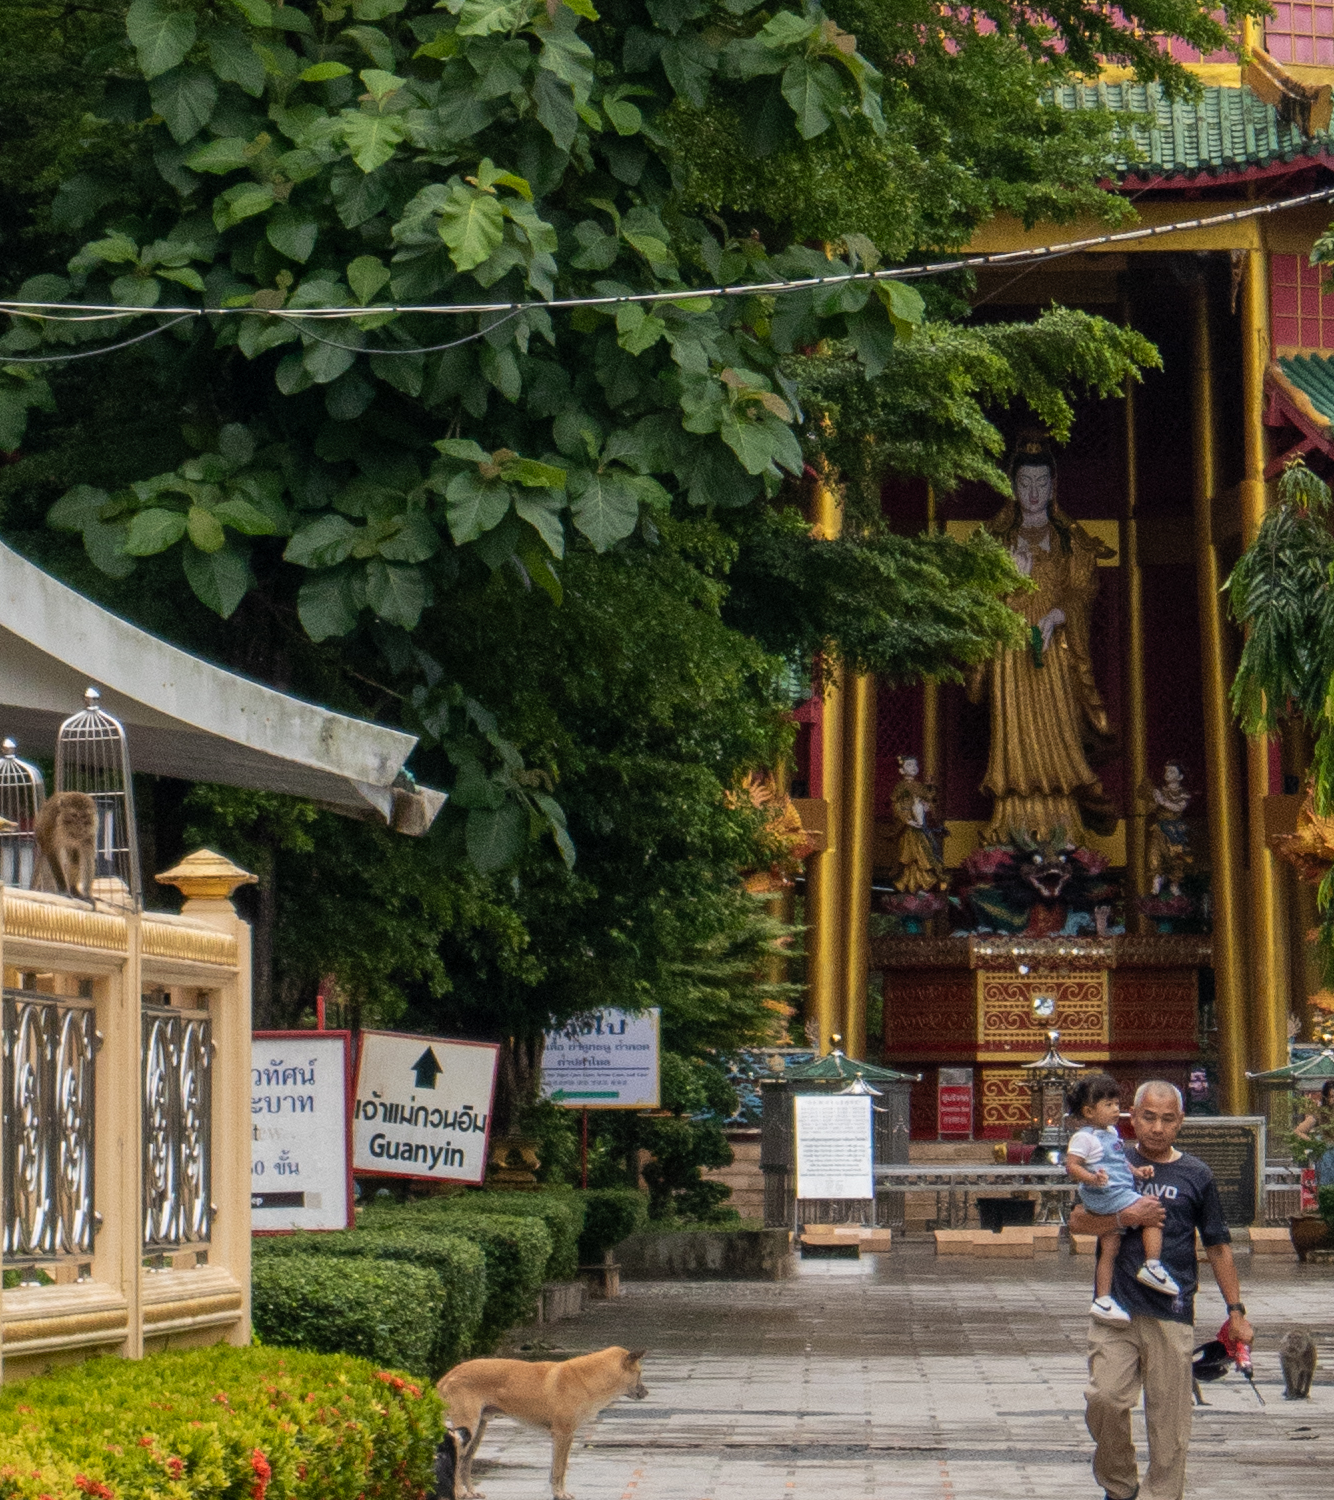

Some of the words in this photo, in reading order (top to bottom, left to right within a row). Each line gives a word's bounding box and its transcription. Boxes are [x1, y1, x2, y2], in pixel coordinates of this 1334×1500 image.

[354, 1090, 488, 1135] เจ้าแม่กวนอิม
[273, 1149, 300, 1176] ขั้น
[369, 1133, 465, 1172] Guanyin
